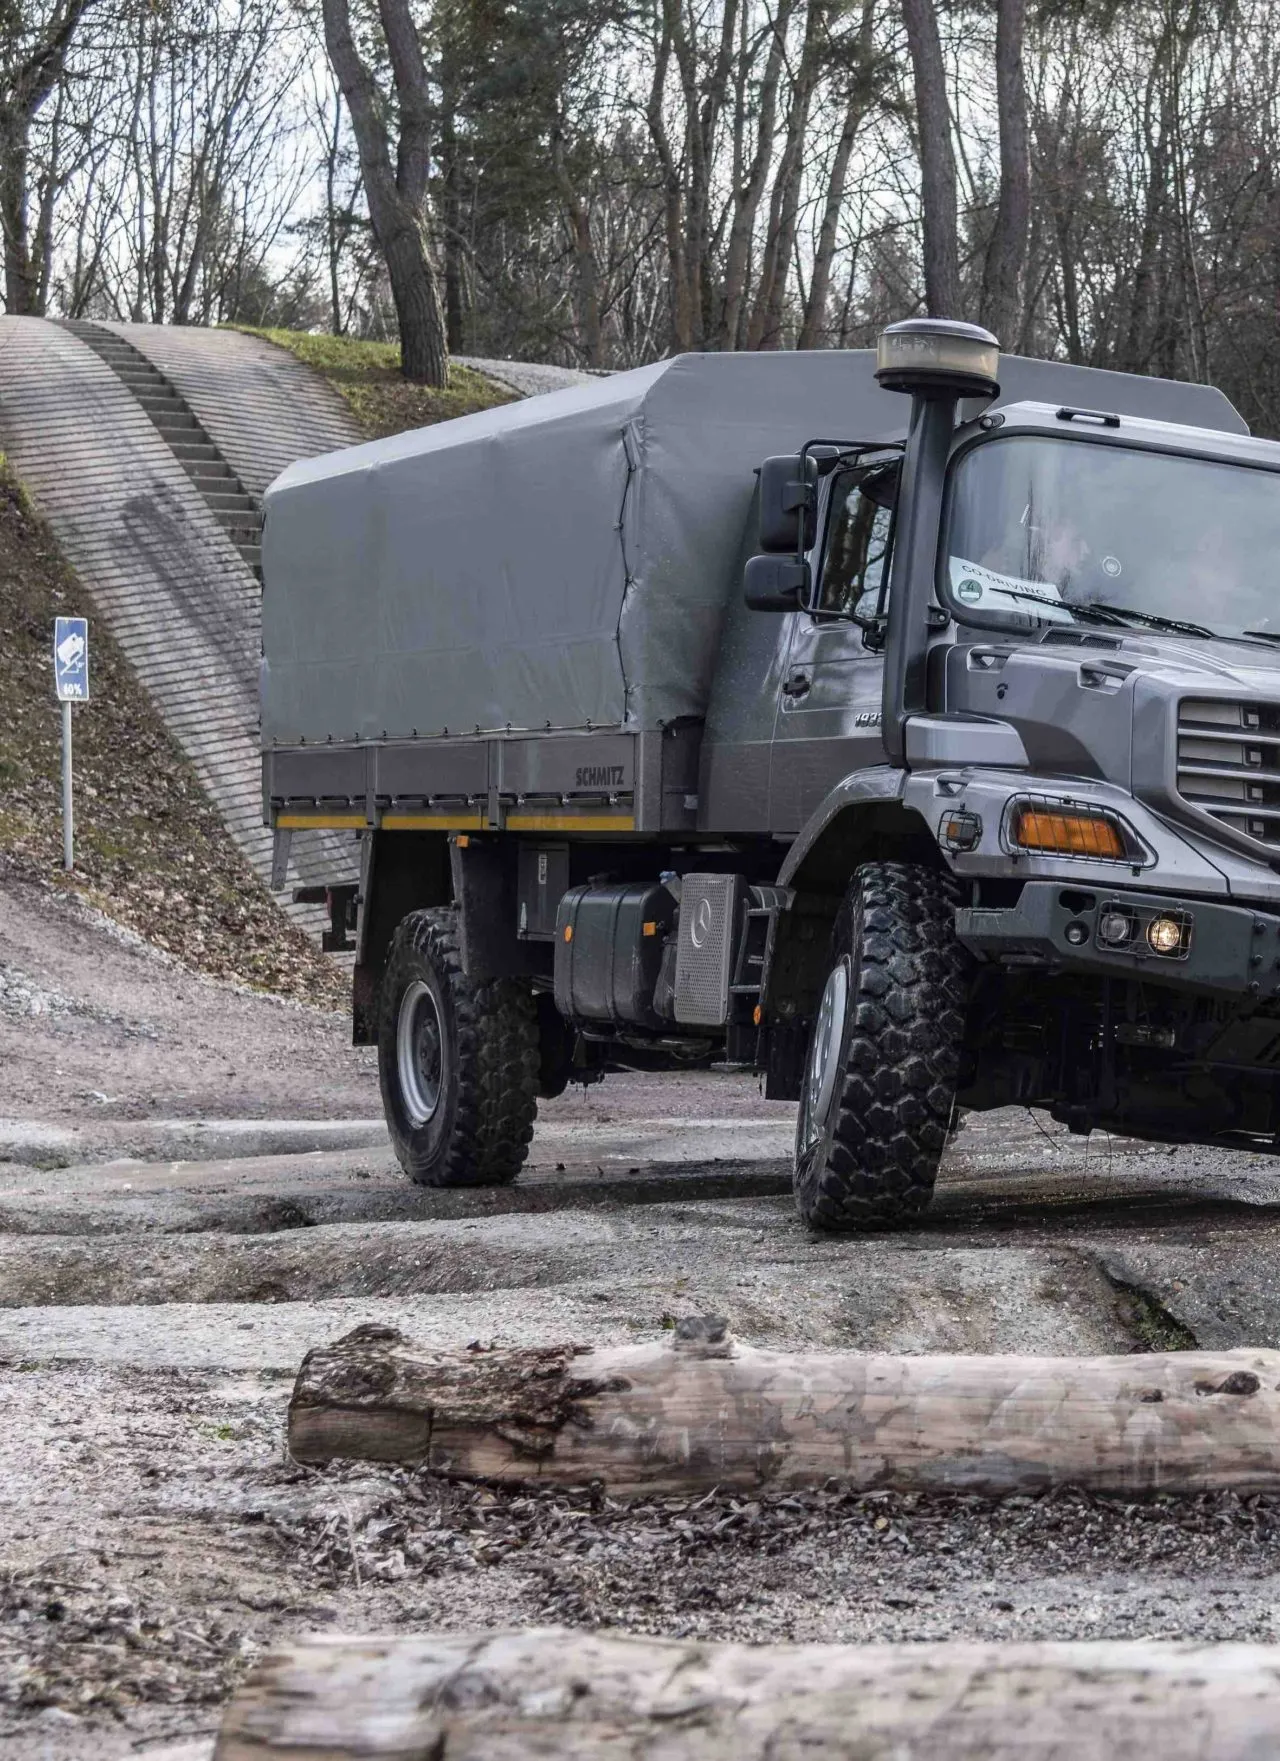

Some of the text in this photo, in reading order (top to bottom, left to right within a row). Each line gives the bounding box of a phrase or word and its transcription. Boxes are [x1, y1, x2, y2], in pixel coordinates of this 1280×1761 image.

[962, 565, 1046, 596] CO-DRIVING
[966, 581, 974, 592] 4
[576, 765, 624, 786] SCHMITZ
